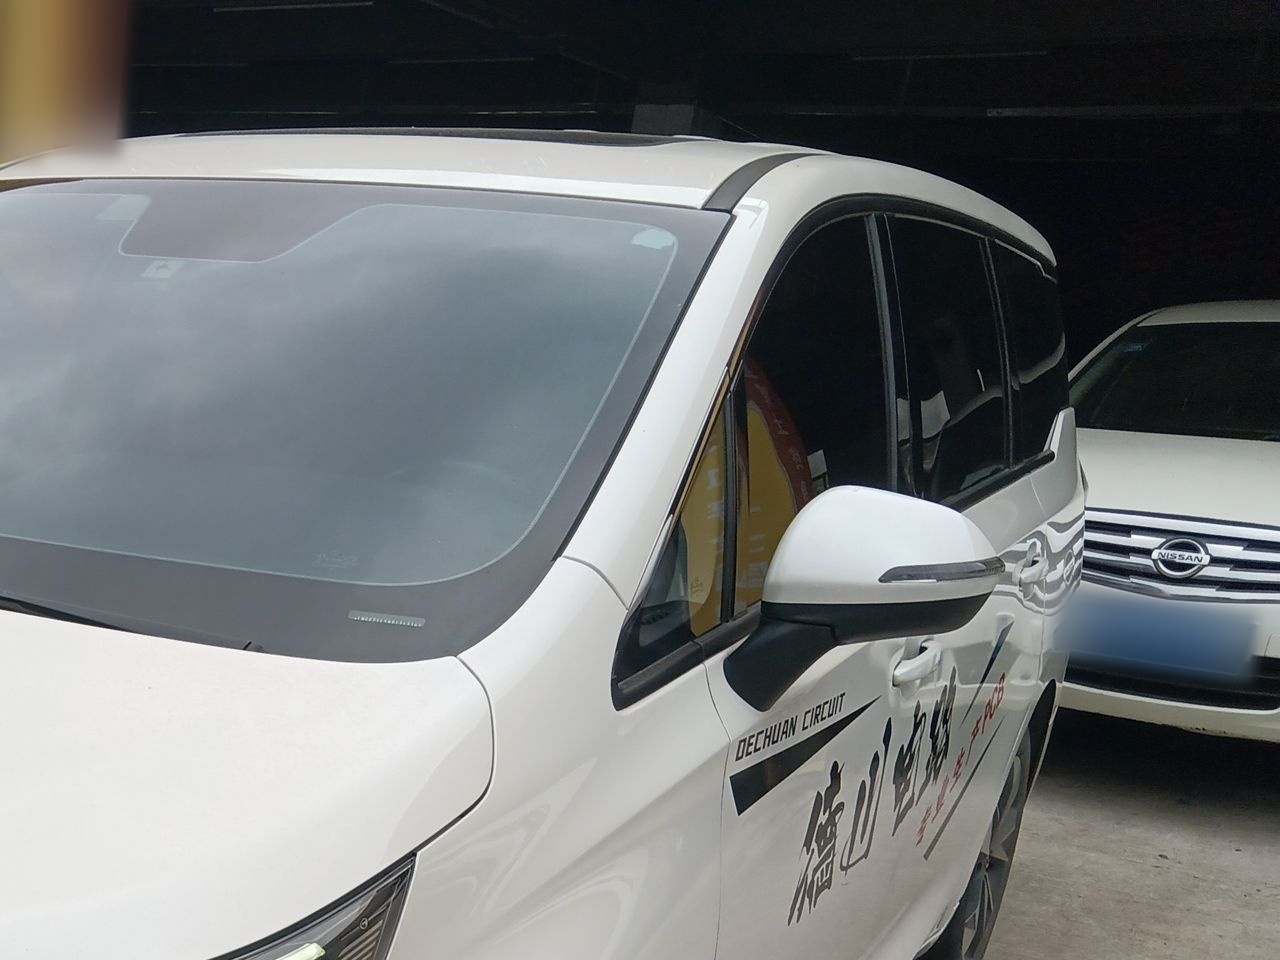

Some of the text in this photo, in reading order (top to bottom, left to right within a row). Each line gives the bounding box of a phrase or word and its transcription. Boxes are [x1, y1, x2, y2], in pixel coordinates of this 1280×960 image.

[1158, 551, 1204, 563] NISSAN
[735, 692, 846, 762] DECHUAN CIRCUIT
